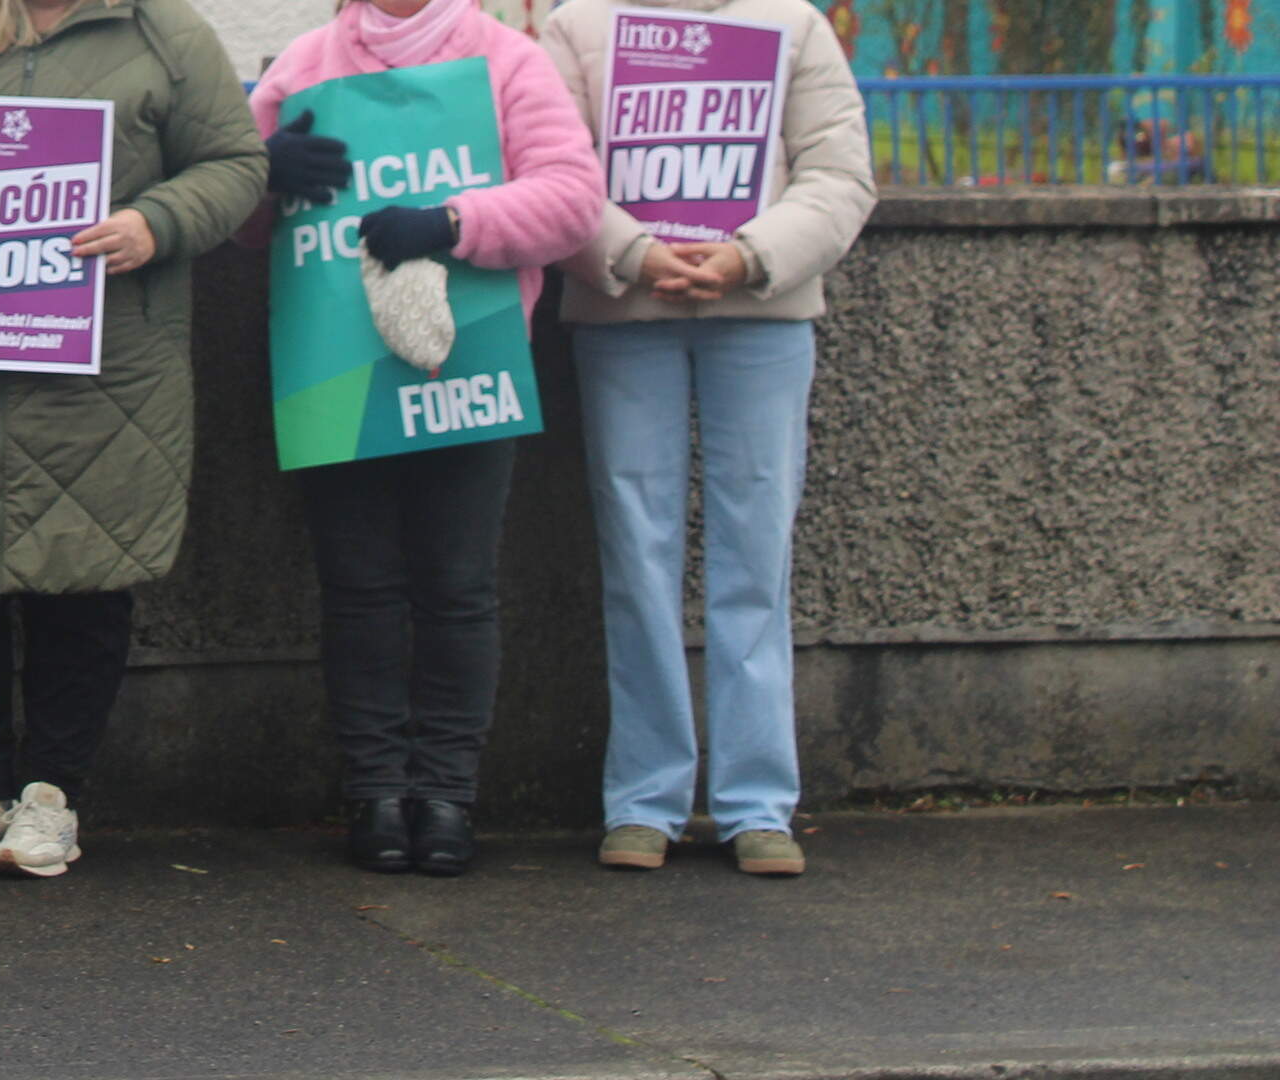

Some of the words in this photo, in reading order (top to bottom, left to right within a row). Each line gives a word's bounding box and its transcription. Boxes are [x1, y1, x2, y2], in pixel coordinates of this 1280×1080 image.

[618, 17, 678, 51] into
[614, 89, 687, 136] FAIR
[698, 87, 767, 132] PAY
[610, 143, 758, 204] NOW!
